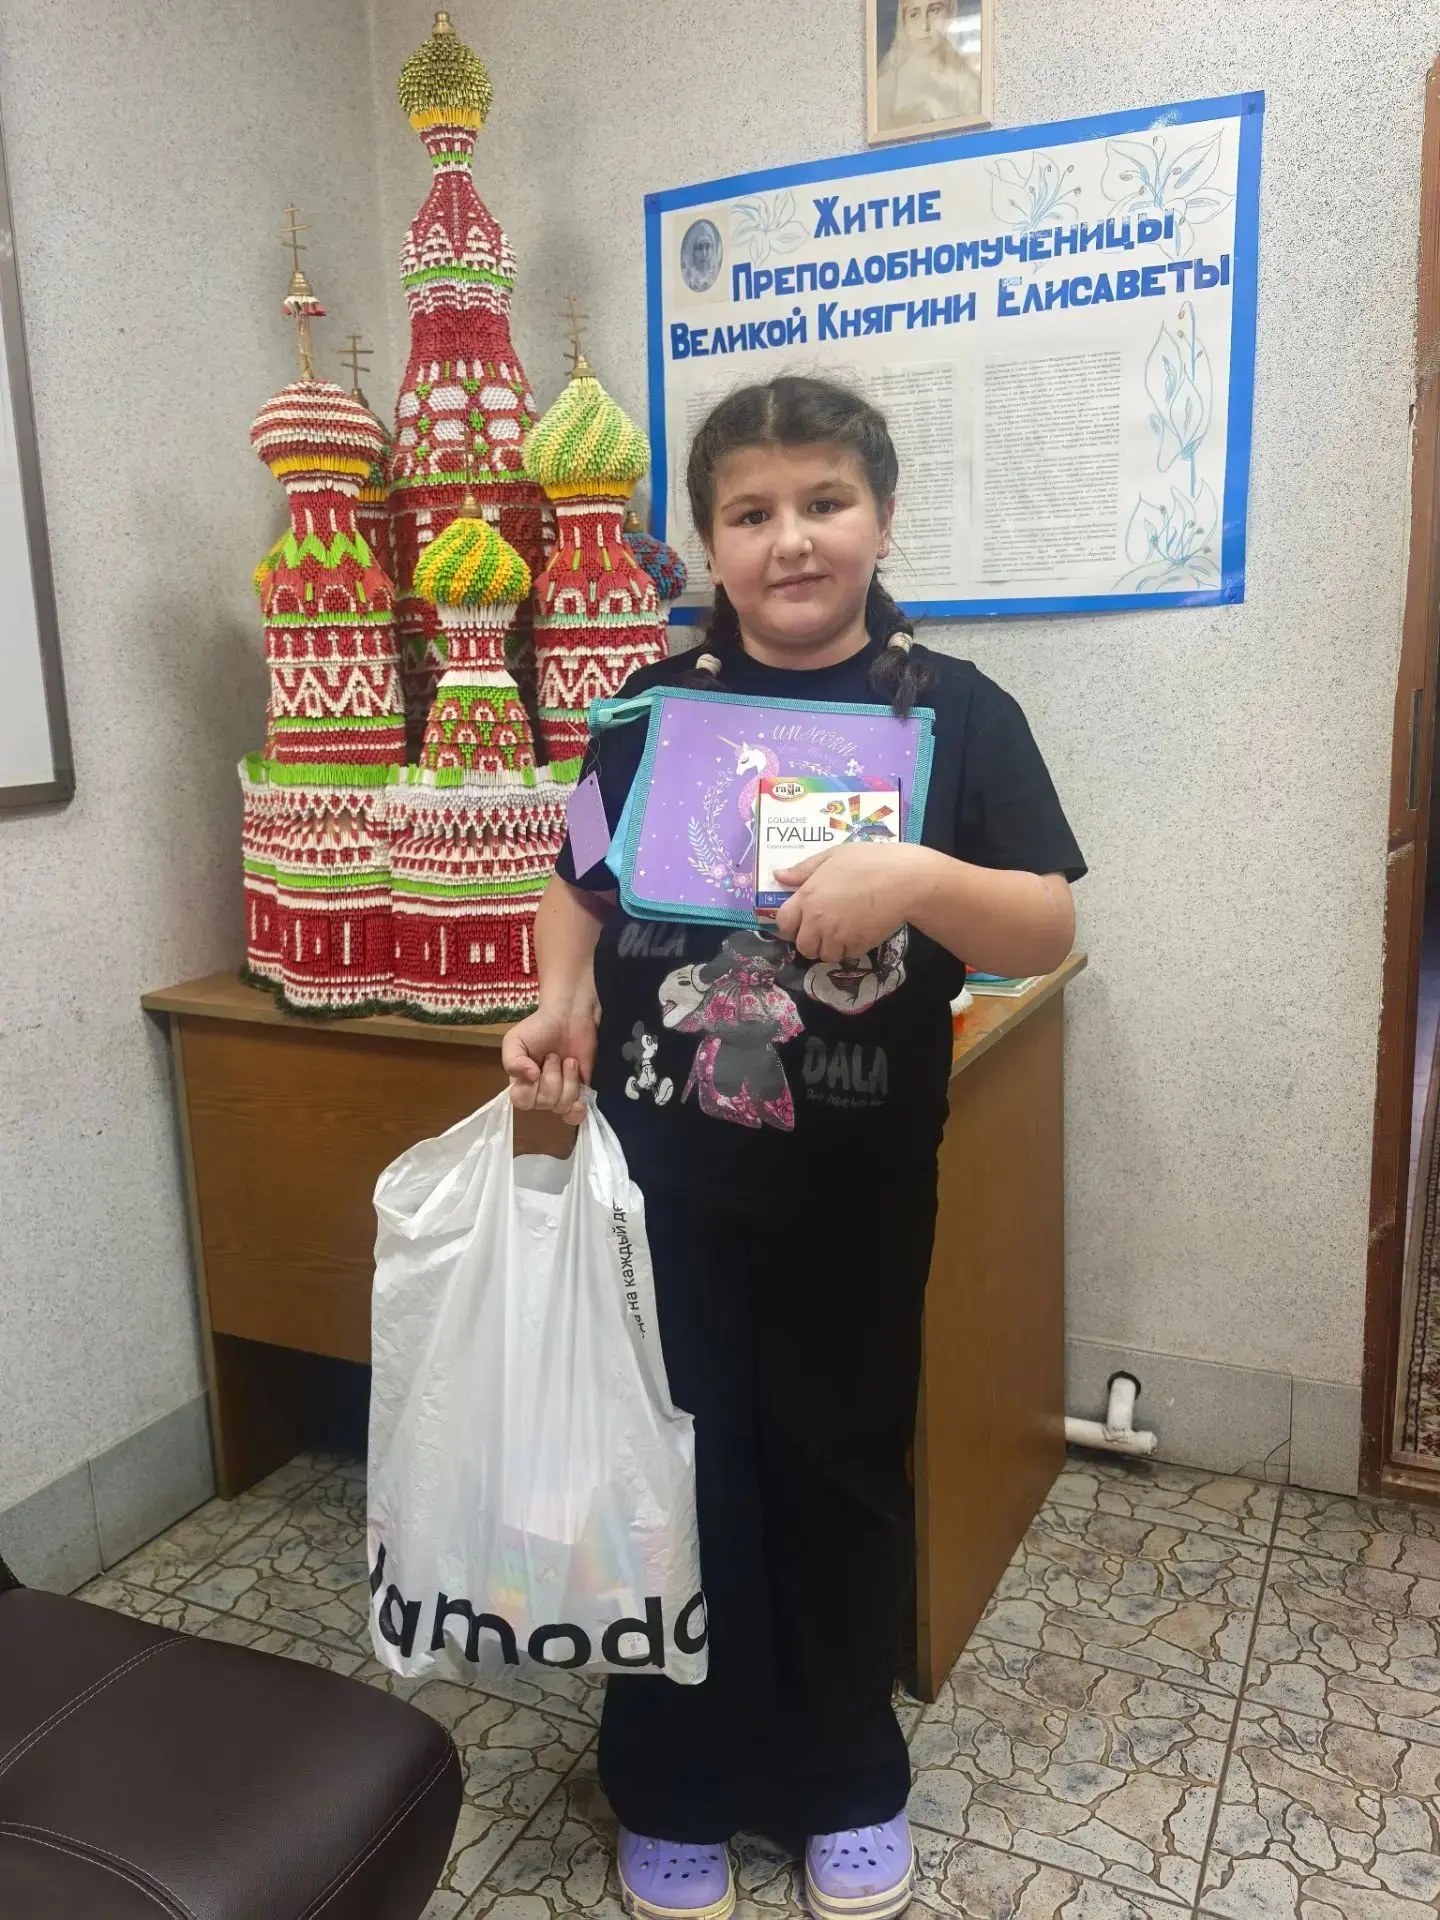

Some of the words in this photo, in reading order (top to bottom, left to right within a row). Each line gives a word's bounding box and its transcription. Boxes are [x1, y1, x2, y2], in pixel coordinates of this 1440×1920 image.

[766, 826, 834, 842] ГУАШЬ
[802, 1036, 889, 1096] DALA
[611, 1225, 637, 1288] каждый
[626, 1291, 640, 1311] на
